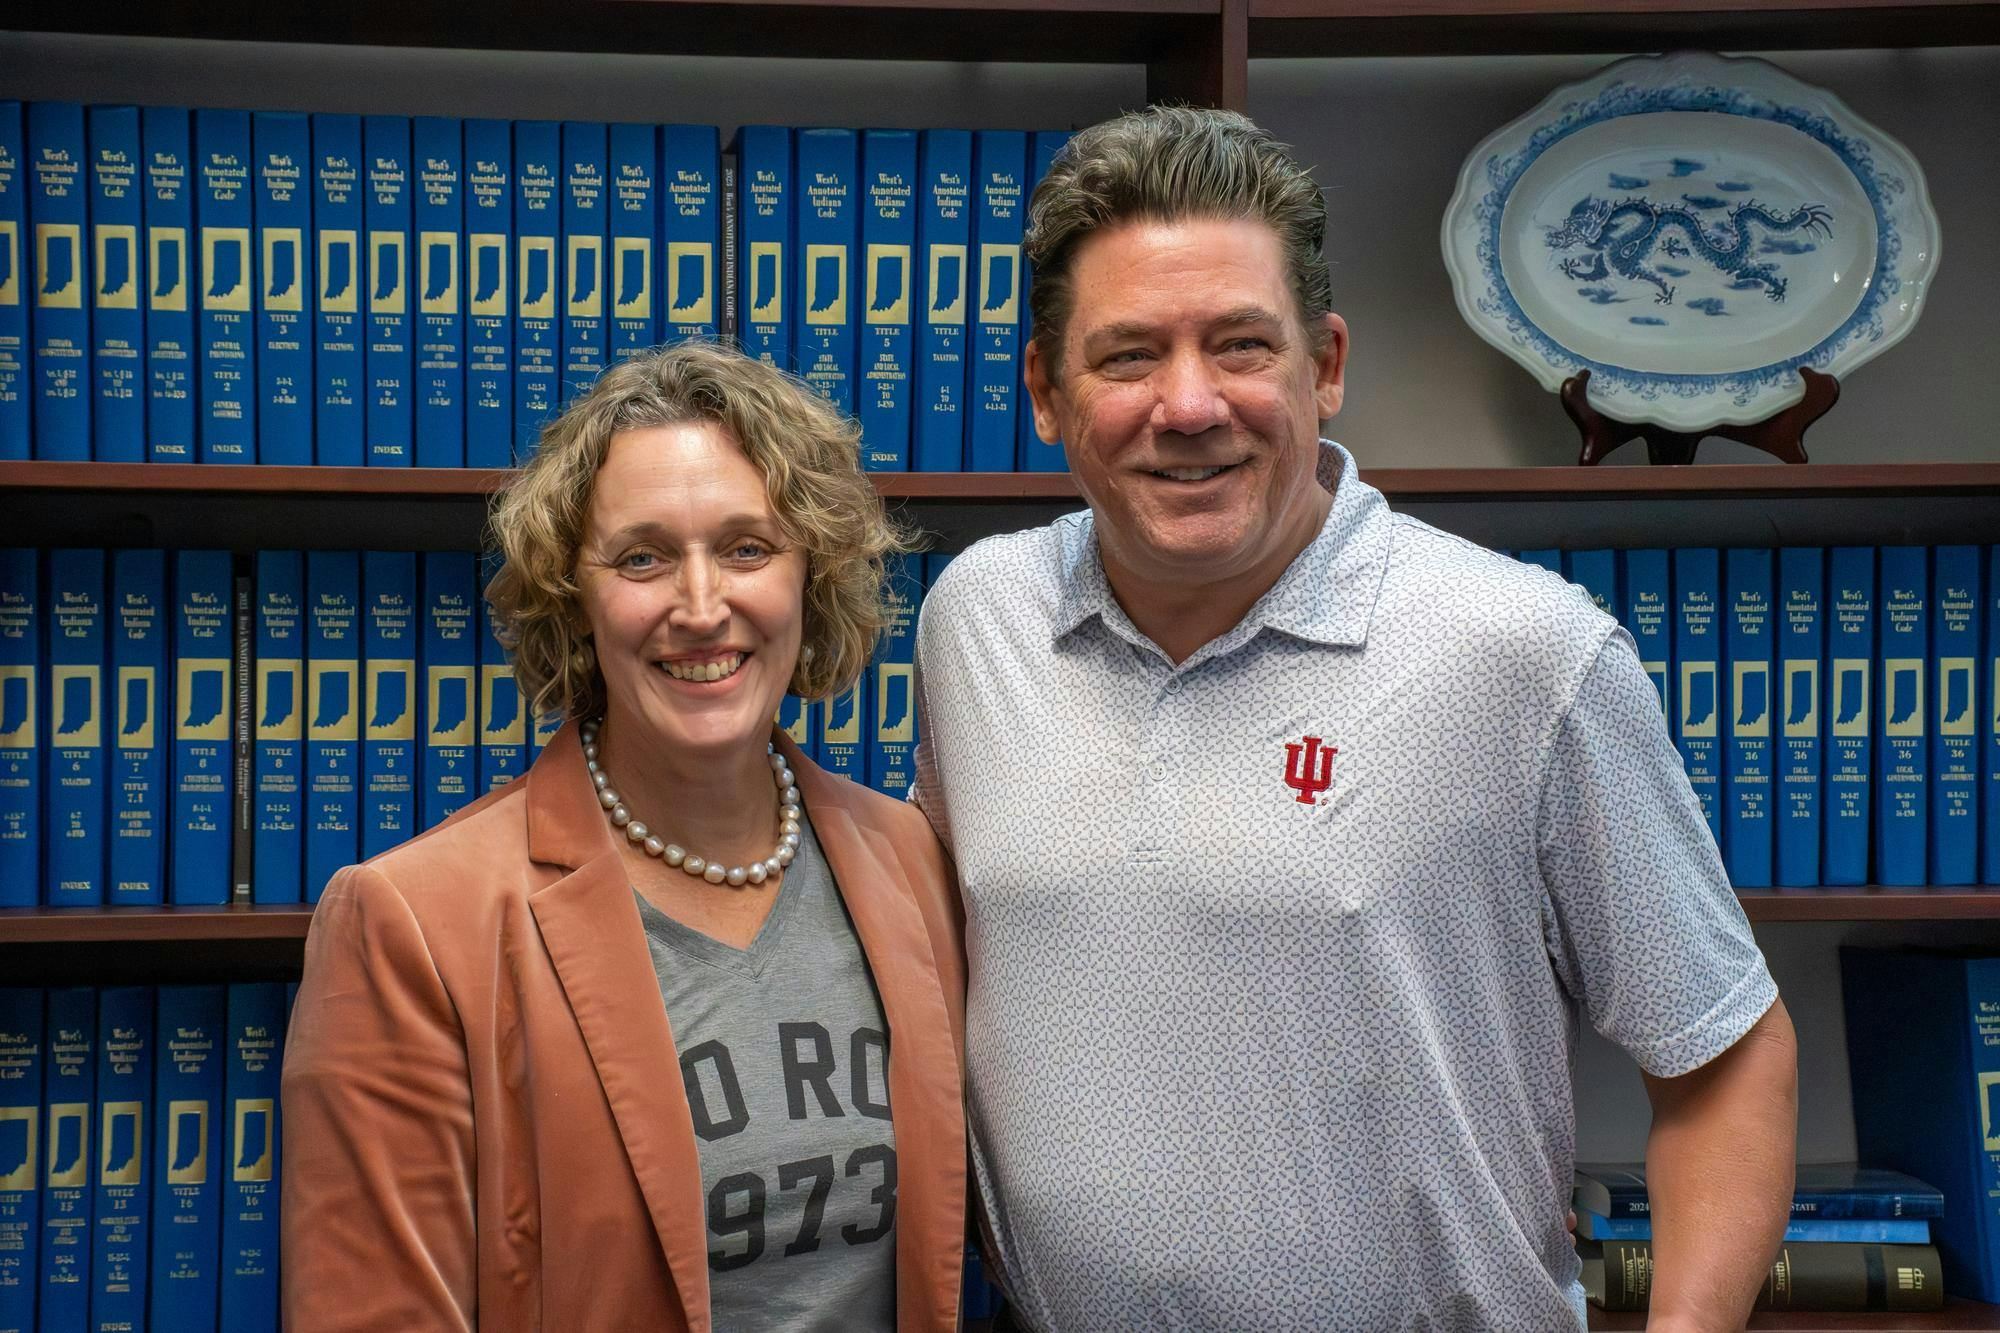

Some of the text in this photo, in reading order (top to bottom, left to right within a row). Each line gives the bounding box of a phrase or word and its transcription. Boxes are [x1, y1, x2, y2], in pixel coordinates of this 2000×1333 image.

[212, 154, 237, 165] West's
[204, 166, 246, 177] Annotated
[477, 162, 498, 172] West's
[575, 164, 595, 175] West's
[470, 174, 505, 184] Annotated
[678, 171, 702, 182] West's
[757, 171, 775, 181] West's
[816, 174, 838, 184] West's
[879, 174, 902, 184] West's
[940, 174, 960, 184] West's
[992, 173, 1013, 184] West's
[209, 178, 241, 189] Indiana
[569, 176, 602, 186] Annotated
[474, 185, 502, 195] Indiana
[573, 187, 598, 197] Indiana
[669, 183, 710, 193] Annotated
[751, 183, 781, 193] Annotated
[808, 185, 846, 196] Annotated
[870, 185, 911, 196] Annotated
[933, 185, 967, 196] Annotated
[985, 185, 1020, 195] Annotated
[214, 190, 235, 200] Code
[675, 194, 705, 204] Indiana
[755, 194, 777, 204] Indiana
[479, 197, 497, 207] Code
[577, 198, 593, 208] Code
[812, 197, 841, 207] Indiana
[875, 197, 905, 207] Indiana
[937, 197, 962, 207] Indiana
[989, 196, 1016, 206] Indiana
[680, 205, 700, 215] Code
[759, 205, 774, 215] Code
[817, 208, 836, 218] Code
[880, 208, 900, 218] Code
[941, 208, 958, 218] Code
[993, 207, 1010, 217] Code
[726, 295, 735, 319] CODE
[214, 314, 240, 322] TITLE
[270, 314, 297, 323] TITLE
[375, 317, 401, 325] TITLE
[475, 319, 501, 327] TITLE
[571, 320, 598, 328] TITLE
[224, 325, 229, 333] 1
[280, 325, 288, 334] 3
[756, 326, 776, 334] TITLE
[814, 328, 838, 336] TITLE
[875, 327, 900, 335] TITLE
[986, 327, 1010, 335] TITLE
[486, 330, 493, 338] 4
[763, 336, 768, 345] 5
[823, 338, 829, 347] 5
[884, 338, 890, 347] 5
[943, 338, 949, 346] 6
[995, 337, 1001, 346] 6
[213, 445, 242, 453] INDEX
[374, 446, 402, 454] INDEX
[871, 452, 897, 461] INDEX
[1640, 593, 1658, 602] West's
[1689, 592, 1708, 601] West's
[1741, 592, 1760, 601] West's
[1792, 591, 1810, 600] West's
[1843, 590, 1862, 600] West's
[1894, 590, 1915, 600] West's
[1947, 589, 1967, 598] West's
[1634, 603, 1664, 613] Annotated
[1683, 603, 1714, 612] Annotated
[1734, 603, 1767, 612] Annotated
[1786, 602, 1817, 611] Annotated
[1836, 601, 1869, 610] Annotated
[1887, 601, 1922, 611] Annotated
[1942, 600, 1974, 610] Annotated
[1638, 614, 1661, 624] Indiana
[1686, 614, 1710, 623] Indiana
[1738, 614, 1763, 623] Indiana
[1789, 613, 1813, 622] Indiana
[1839, 612, 1865, 621] Indiana
[1891, 612, 1918, 622] Indiana
[1945, 611, 1969, 620] Indiana
[1642, 625, 1657, 635] Code
[1690, 625, 1706, 634] Code
[1742, 624, 1759, 634] Code
[1793, 624, 1808, 633] Code
[1843, 623, 1860, 632] Code
[1895, 623, 1912, 632] Code
[1949, 622, 1965, 631] Code
[265, 748, 292, 756] TITLE
[321, 748, 347, 756] TITLE
[378, 748, 403, 756] TITLE
[1694, 752, 1706, 760] 36
[1745, 752, 1758, 760] 36
[1794, 751, 1807, 760] 36
[1844, 750, 1856, 759] 36
[1899, 750, 1912, 759] 36
[1952, 749, 1964, 757] 36
[836, 757, 847, 766] 12
[890, 756, 901, 765] 12
[1629, 1202, 1650, 1212] 2024
[1774, 1261, 1785, 1291] Smith
